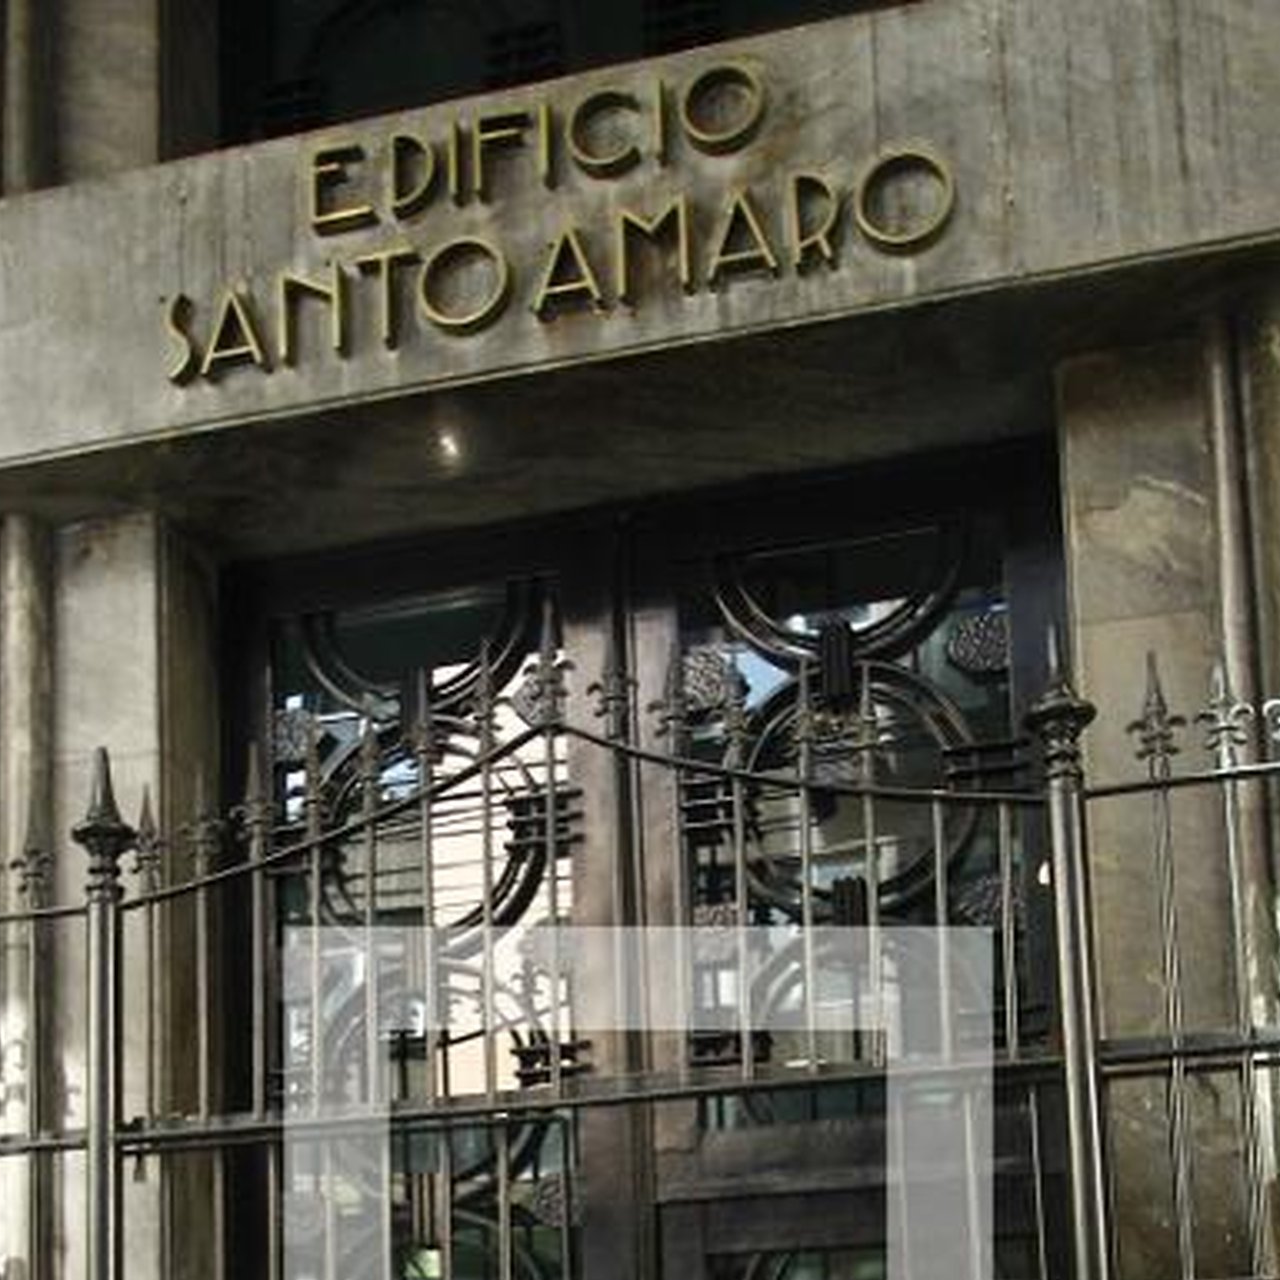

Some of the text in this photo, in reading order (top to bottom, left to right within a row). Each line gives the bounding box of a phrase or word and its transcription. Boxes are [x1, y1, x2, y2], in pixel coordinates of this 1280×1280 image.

[310, 63, 764, 236] EDIFICIO
[166, 150, 955, 384] SANTO AMARO
